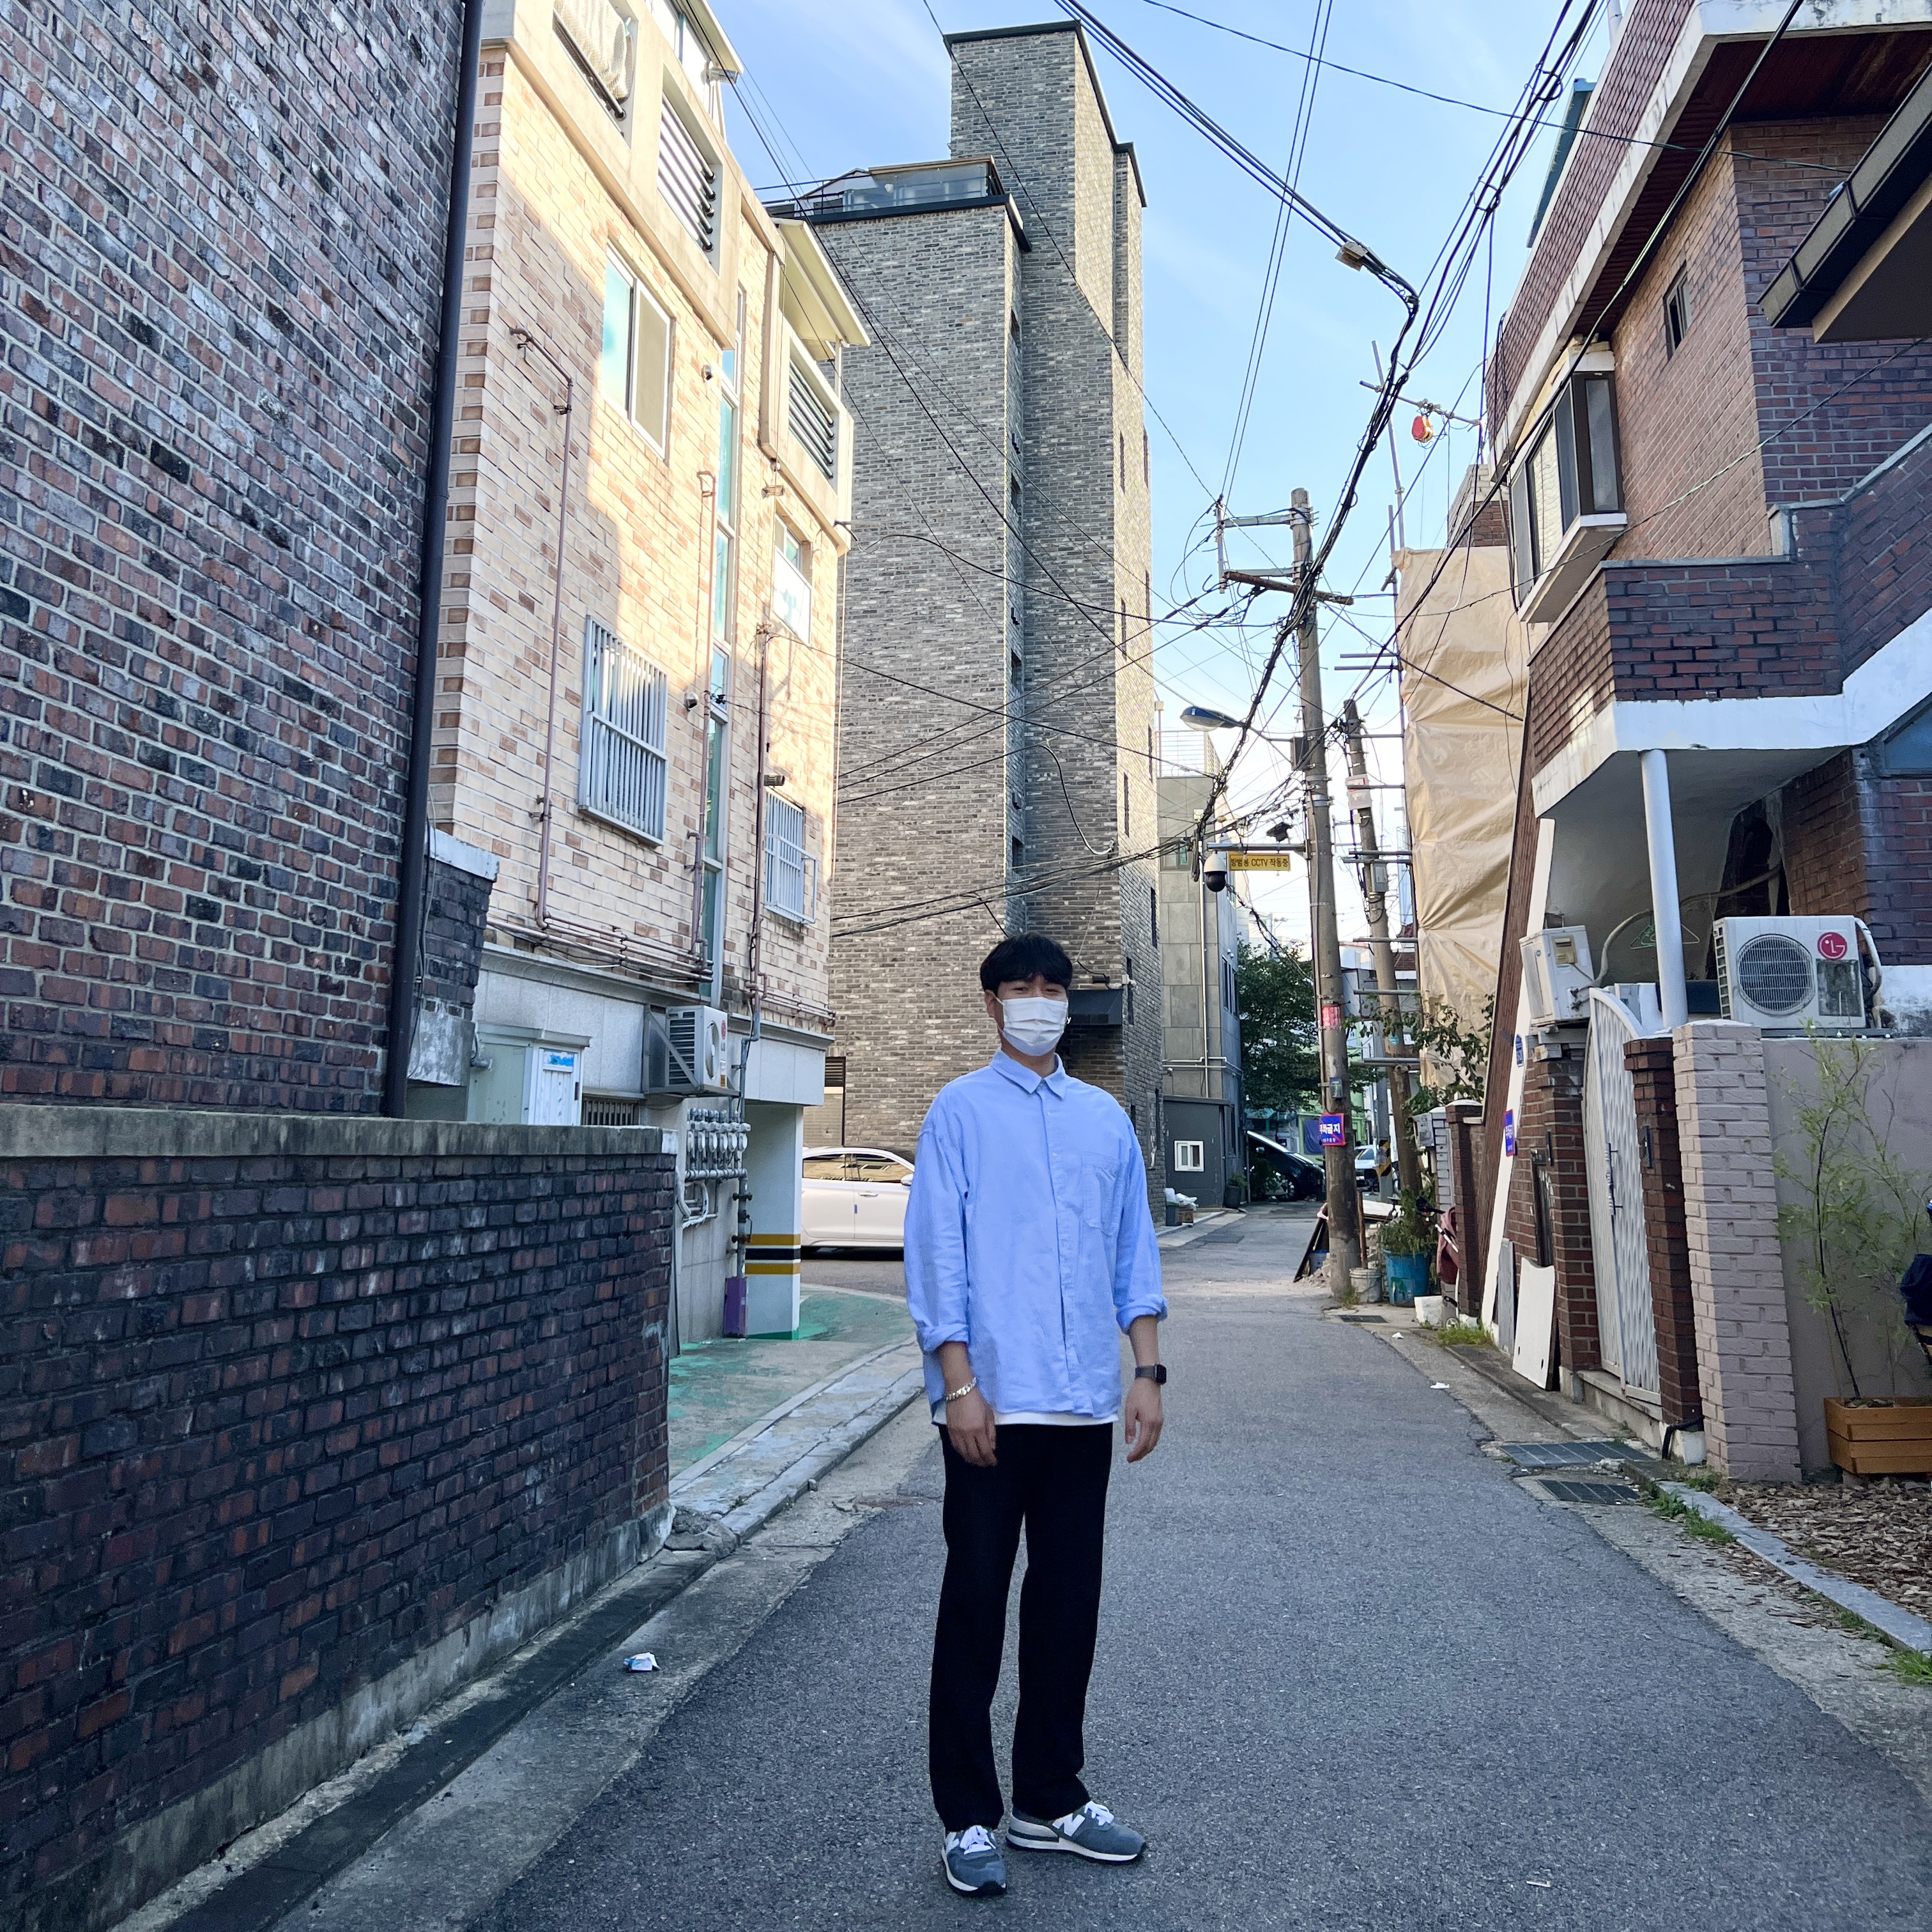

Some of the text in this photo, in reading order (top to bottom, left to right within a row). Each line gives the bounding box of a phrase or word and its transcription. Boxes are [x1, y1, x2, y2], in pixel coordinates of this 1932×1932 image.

[1230, 857, 1289, 868] 방범용 CCTV 작동중
[1819, 933, 1846, 960] LG
[1052, 1813, 1085, 1837] N
